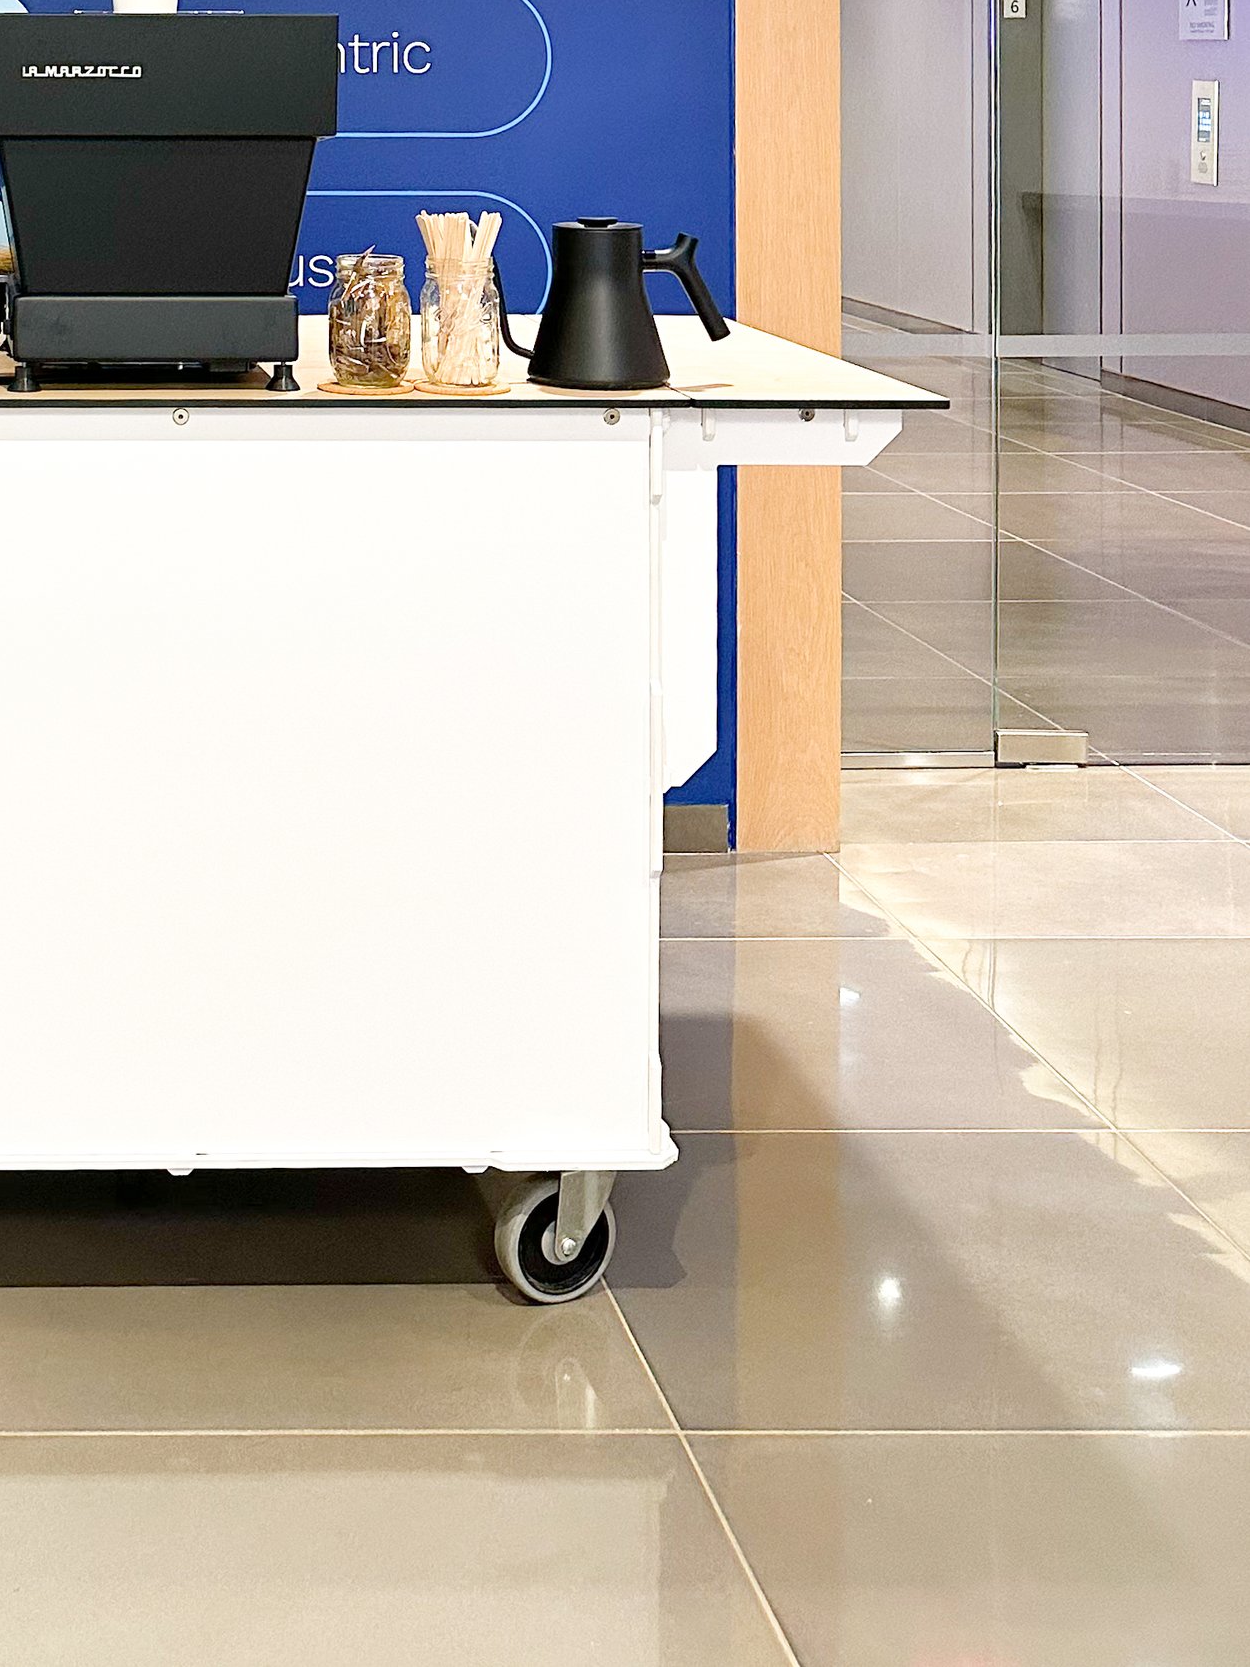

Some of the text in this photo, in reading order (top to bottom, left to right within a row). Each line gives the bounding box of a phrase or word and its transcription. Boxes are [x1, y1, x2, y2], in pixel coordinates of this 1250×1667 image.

[1010, 0, 1020, 14] 6
[22, 65, 142, 78] LA MARZOCCO
